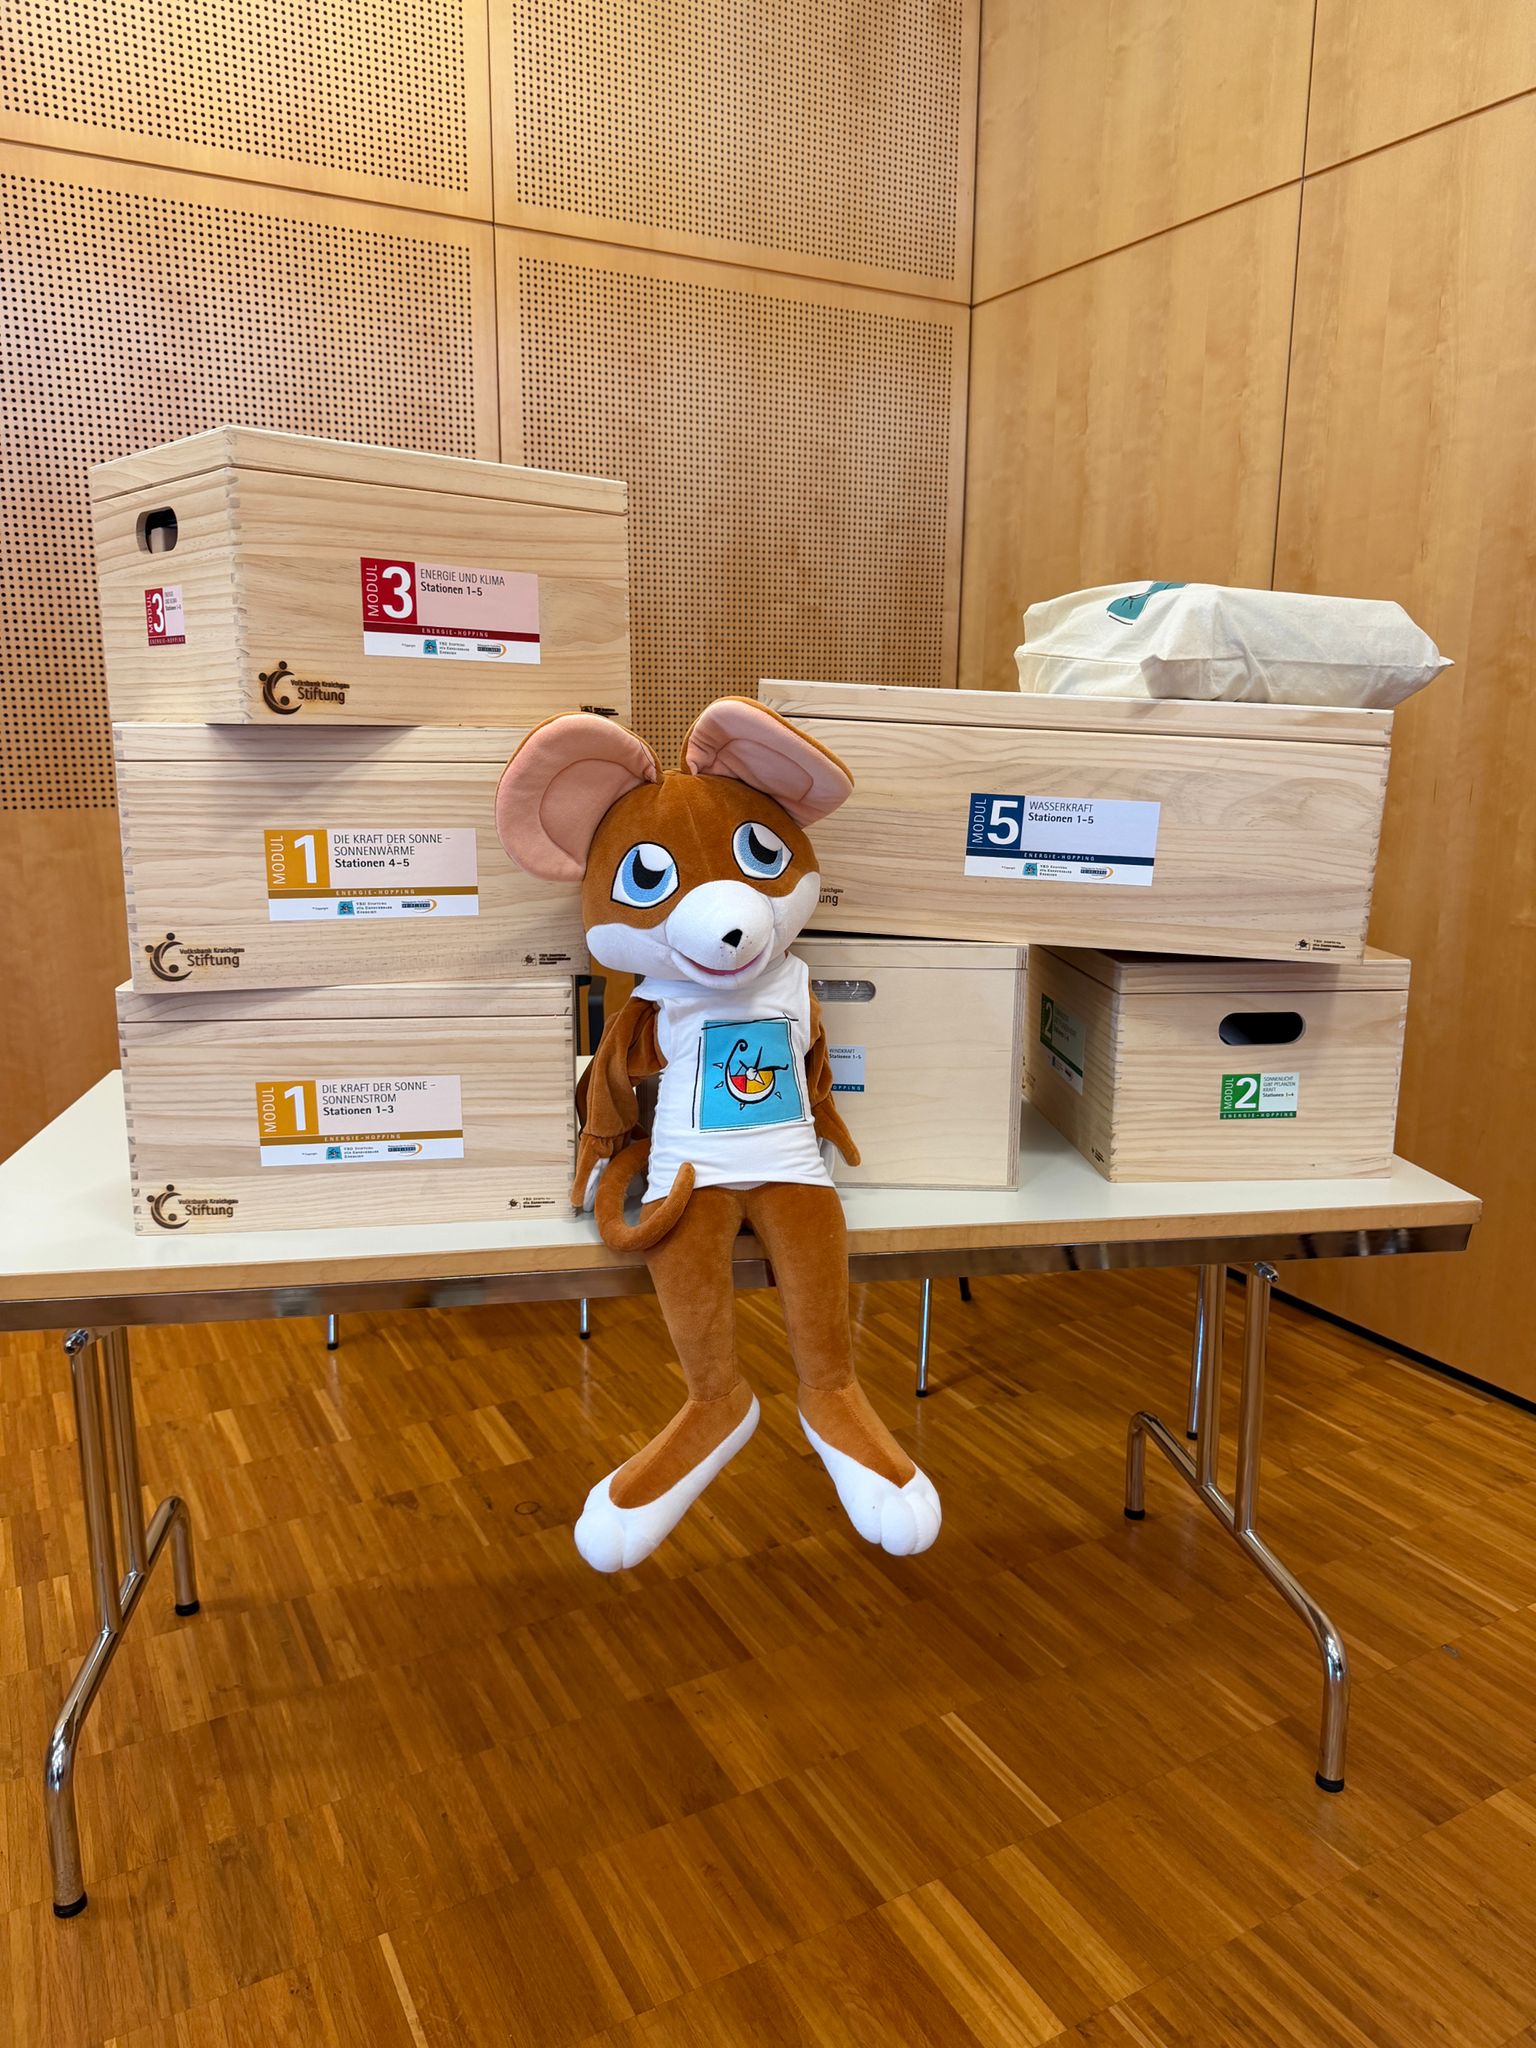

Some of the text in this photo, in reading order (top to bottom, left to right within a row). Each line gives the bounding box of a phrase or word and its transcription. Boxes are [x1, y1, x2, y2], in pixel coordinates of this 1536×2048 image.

[420, 568, 505, 586] ENERGIE UND KLIMA
[366, 564, 379, 617] MODUL
[382, 566, 413, 619] 3
[420, 581, 464, 594] Stationen
[152, 593, 164, 633] 3
[297, 686, 345, 705] Stiftung
[1029, 801, 1093, 813] WASSERKRAFT
[972, 798, 987, 844] MODUL
[987, 800, 1019, 845] 5
[1028, 812, 1073, 823] Stationen
[334, 834, 350, 844] DIE
[353, 834, 383, 844] KRAFT
[387, 834, 406, 844] DER
[409, 833, 442, 844] SONNE
[334, 844, 415, 856] SONNENWÄRME
[1024, 853, 1095, 862] ENERGIE-HOPPING
[271, 835, 286, 885] MODUL
[294, 834, 318, 884] 1
[335, 858, 385, 868] Stationen
[187, 953, 240, 968] Stiftung
[322, 1084, 337, 1094] DIE
[340, 1083, 370, 1093] KRAFT
[373, 1082, 391, 1092] DER
[394, 1081, 427, 1091] SONNE
[1223, 1078, 1234, 1110] MODUL
[1234, 1077, 1258, 1109] 2
[322, 1093, 397, 1105] SONNENSTROM
[262, 1087, 277, 1133] MODUL
[284, 1085, 307, 1131] 1
[323, 1106, 372, 1116] Stationen
[324, 1133, 401, 1142] ENERGIE-HOPPING
[185, 1203, 234, 1218] Stiftung
